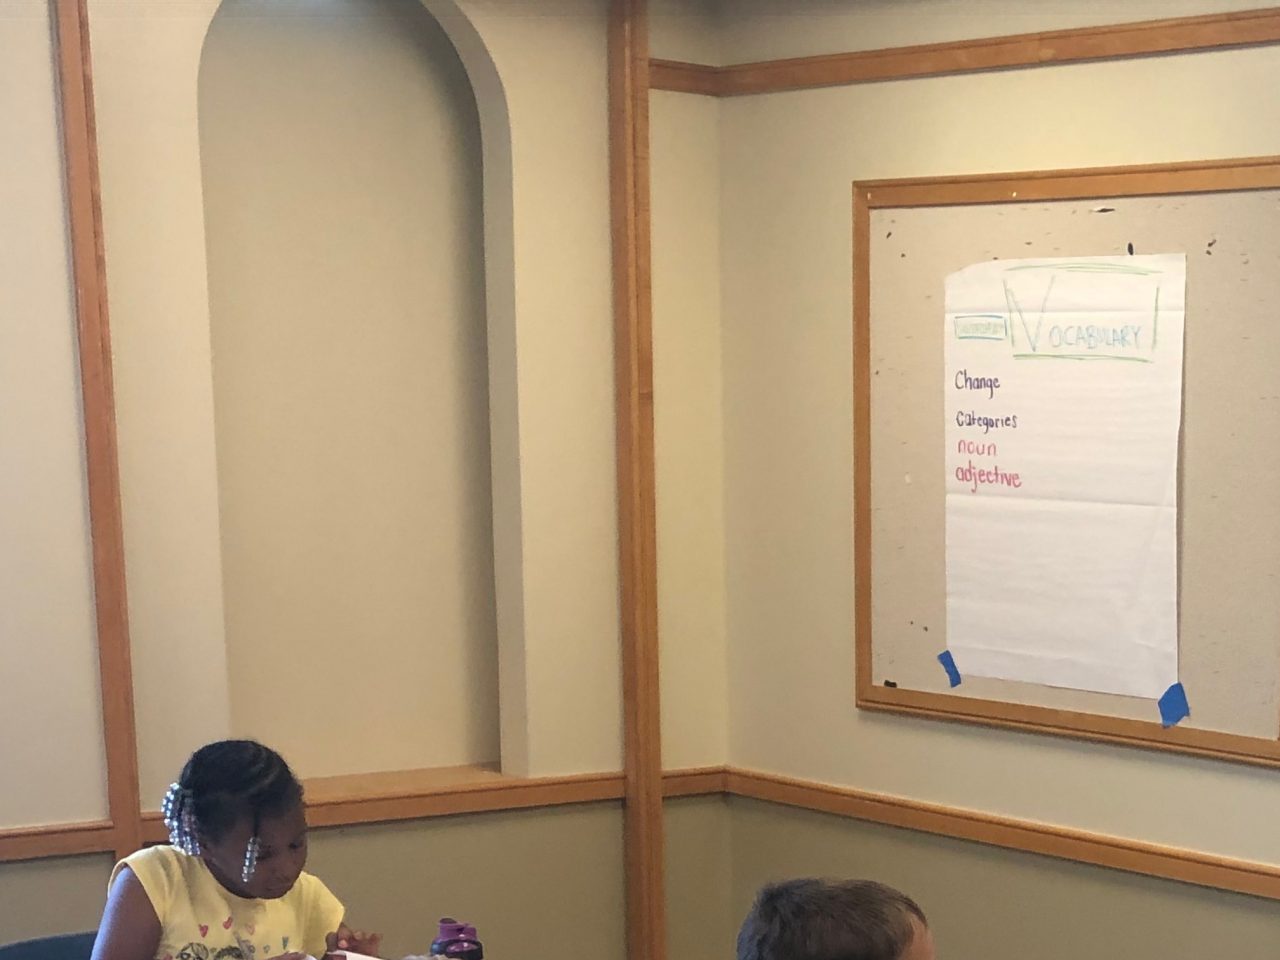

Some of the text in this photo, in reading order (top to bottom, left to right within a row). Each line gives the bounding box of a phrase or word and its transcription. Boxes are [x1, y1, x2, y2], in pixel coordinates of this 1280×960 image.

[1007, 276, 1142, 352] VOCABULARY
[955, 369, 1000, 400] Change
[957, 439, 997, 456] noun
[955, 461, 1022, 493] adjective
